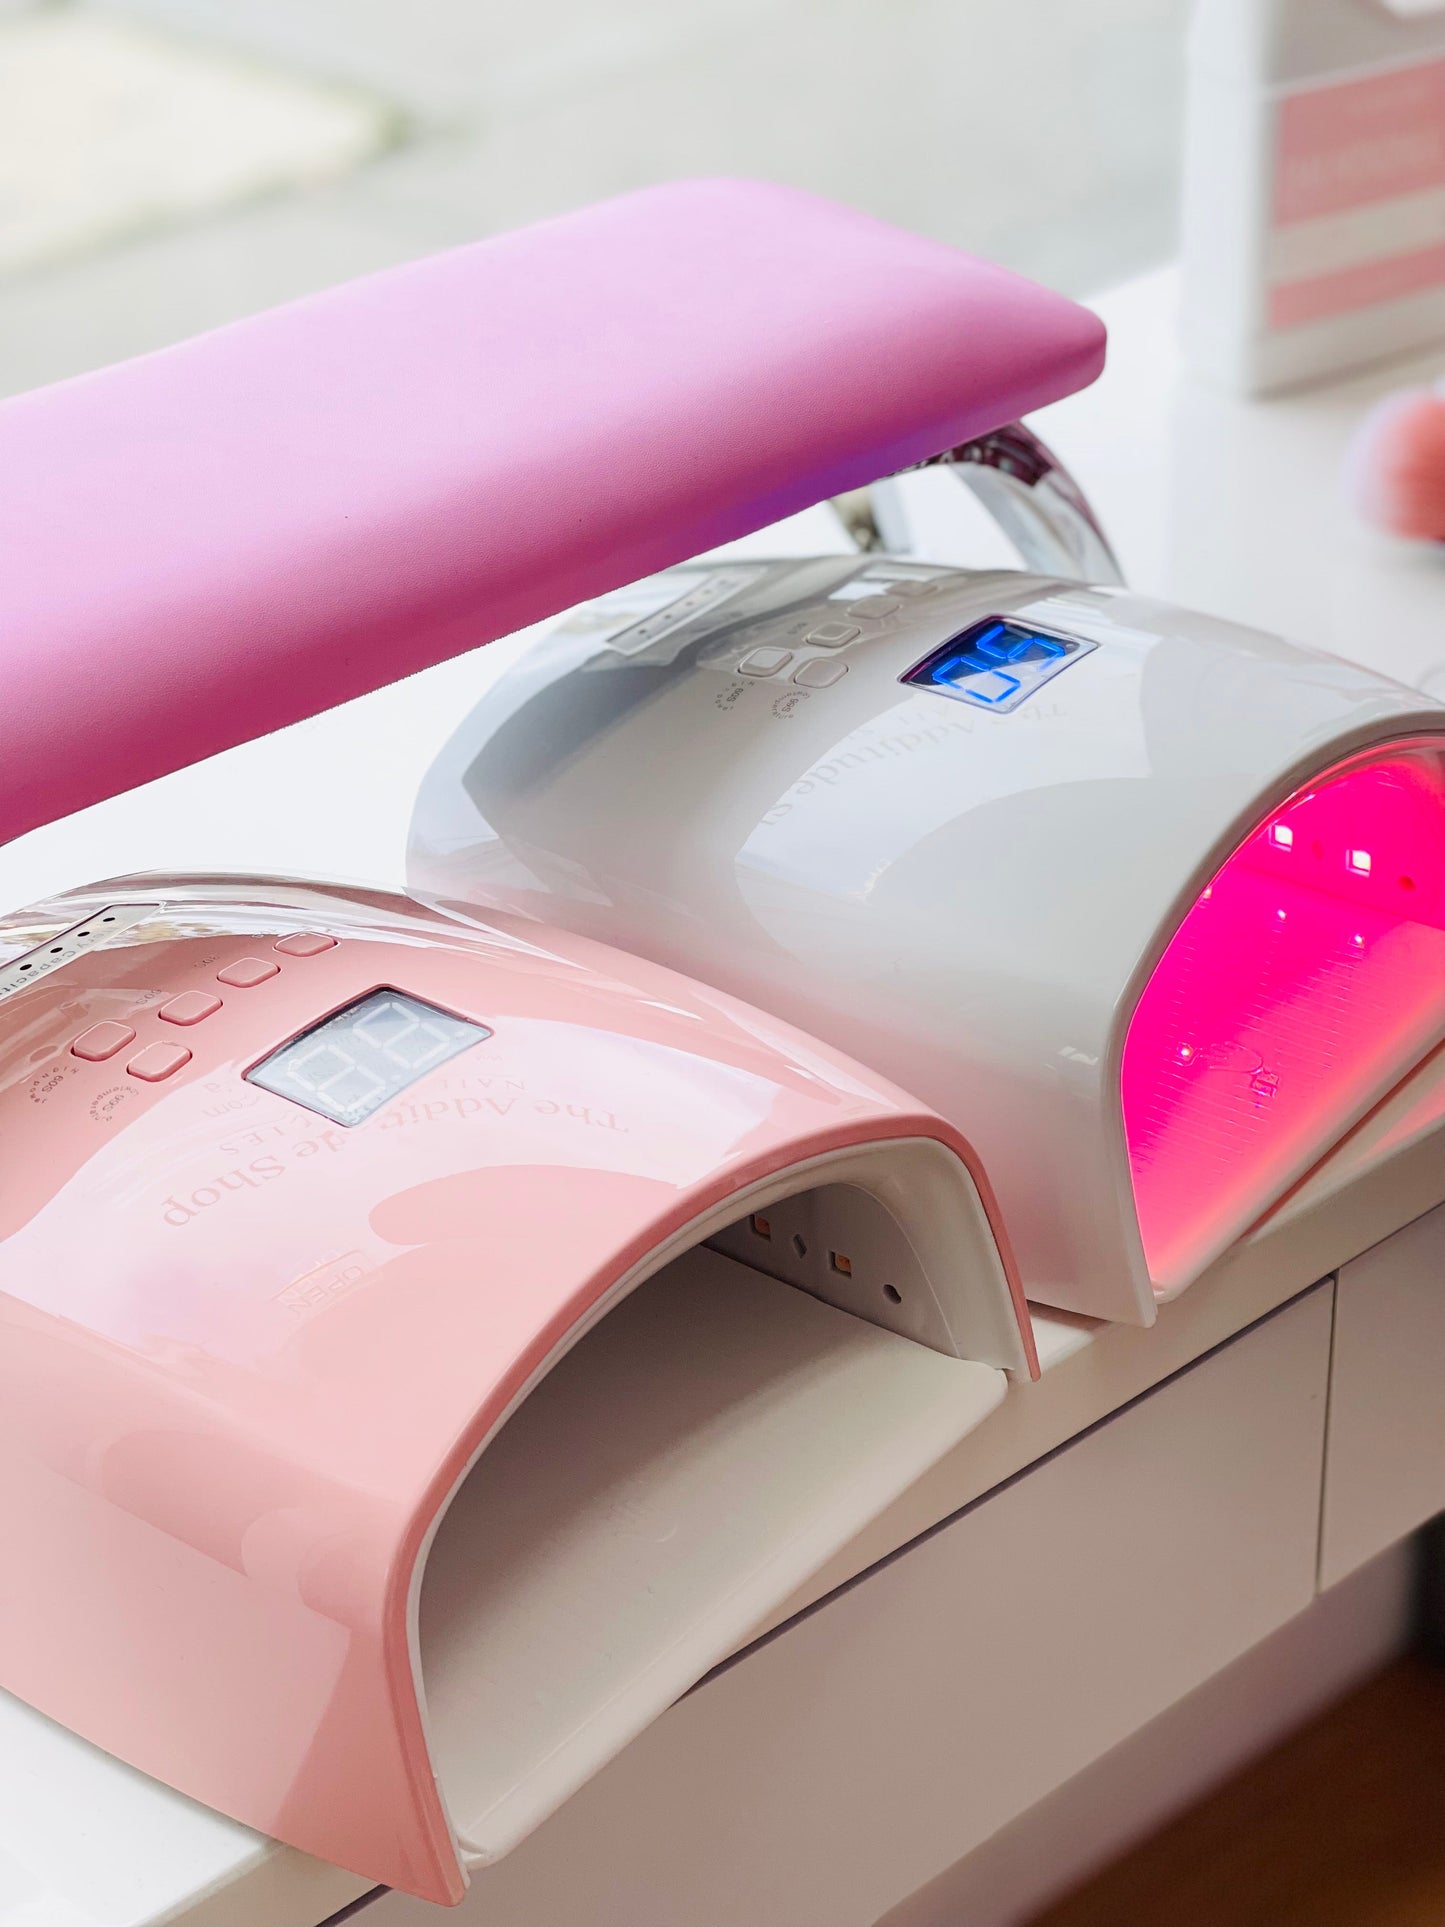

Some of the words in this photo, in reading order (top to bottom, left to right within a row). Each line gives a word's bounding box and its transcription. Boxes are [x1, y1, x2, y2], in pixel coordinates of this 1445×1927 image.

[0, 950, 77, 995] Capacit
[291, 1098, 518, 1157] Additde
[532, 1099, 629, 1133] The
[161, 1155, 286, 1227] Shop
